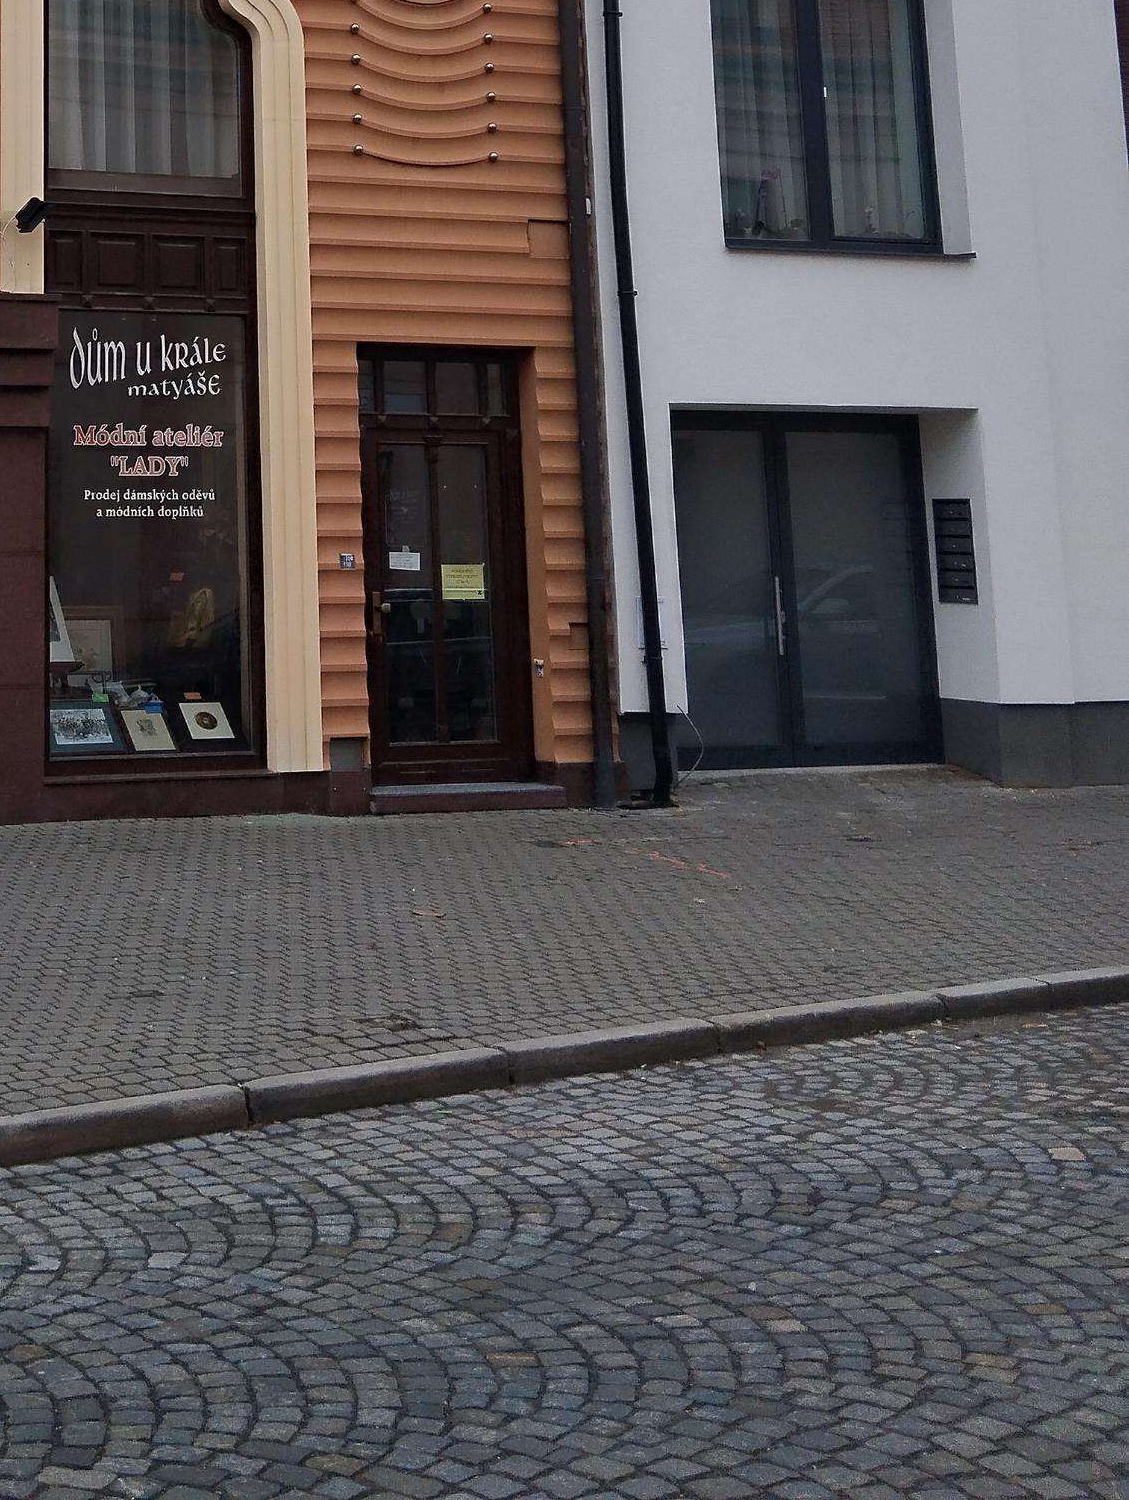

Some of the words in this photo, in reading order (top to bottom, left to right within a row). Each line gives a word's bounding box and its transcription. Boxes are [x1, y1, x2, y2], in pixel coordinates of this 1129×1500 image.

[136, 341, 152, 376] u
[127, 370, 221, 400] matyáše
[73, 422, 147, 447] Módní
[152, 423, 224, 447] ateliér
[110, 455, 189, 477] "LADY"
[83, 489, 120, 502] Prodej
[123, 488, 179, 503] dámských
[182, 488, 216, 501] oděvů
[96, 508, 103, 517] a
[105, 505, 155, 517] módních
[157, 505, 204, 520] doplňků
